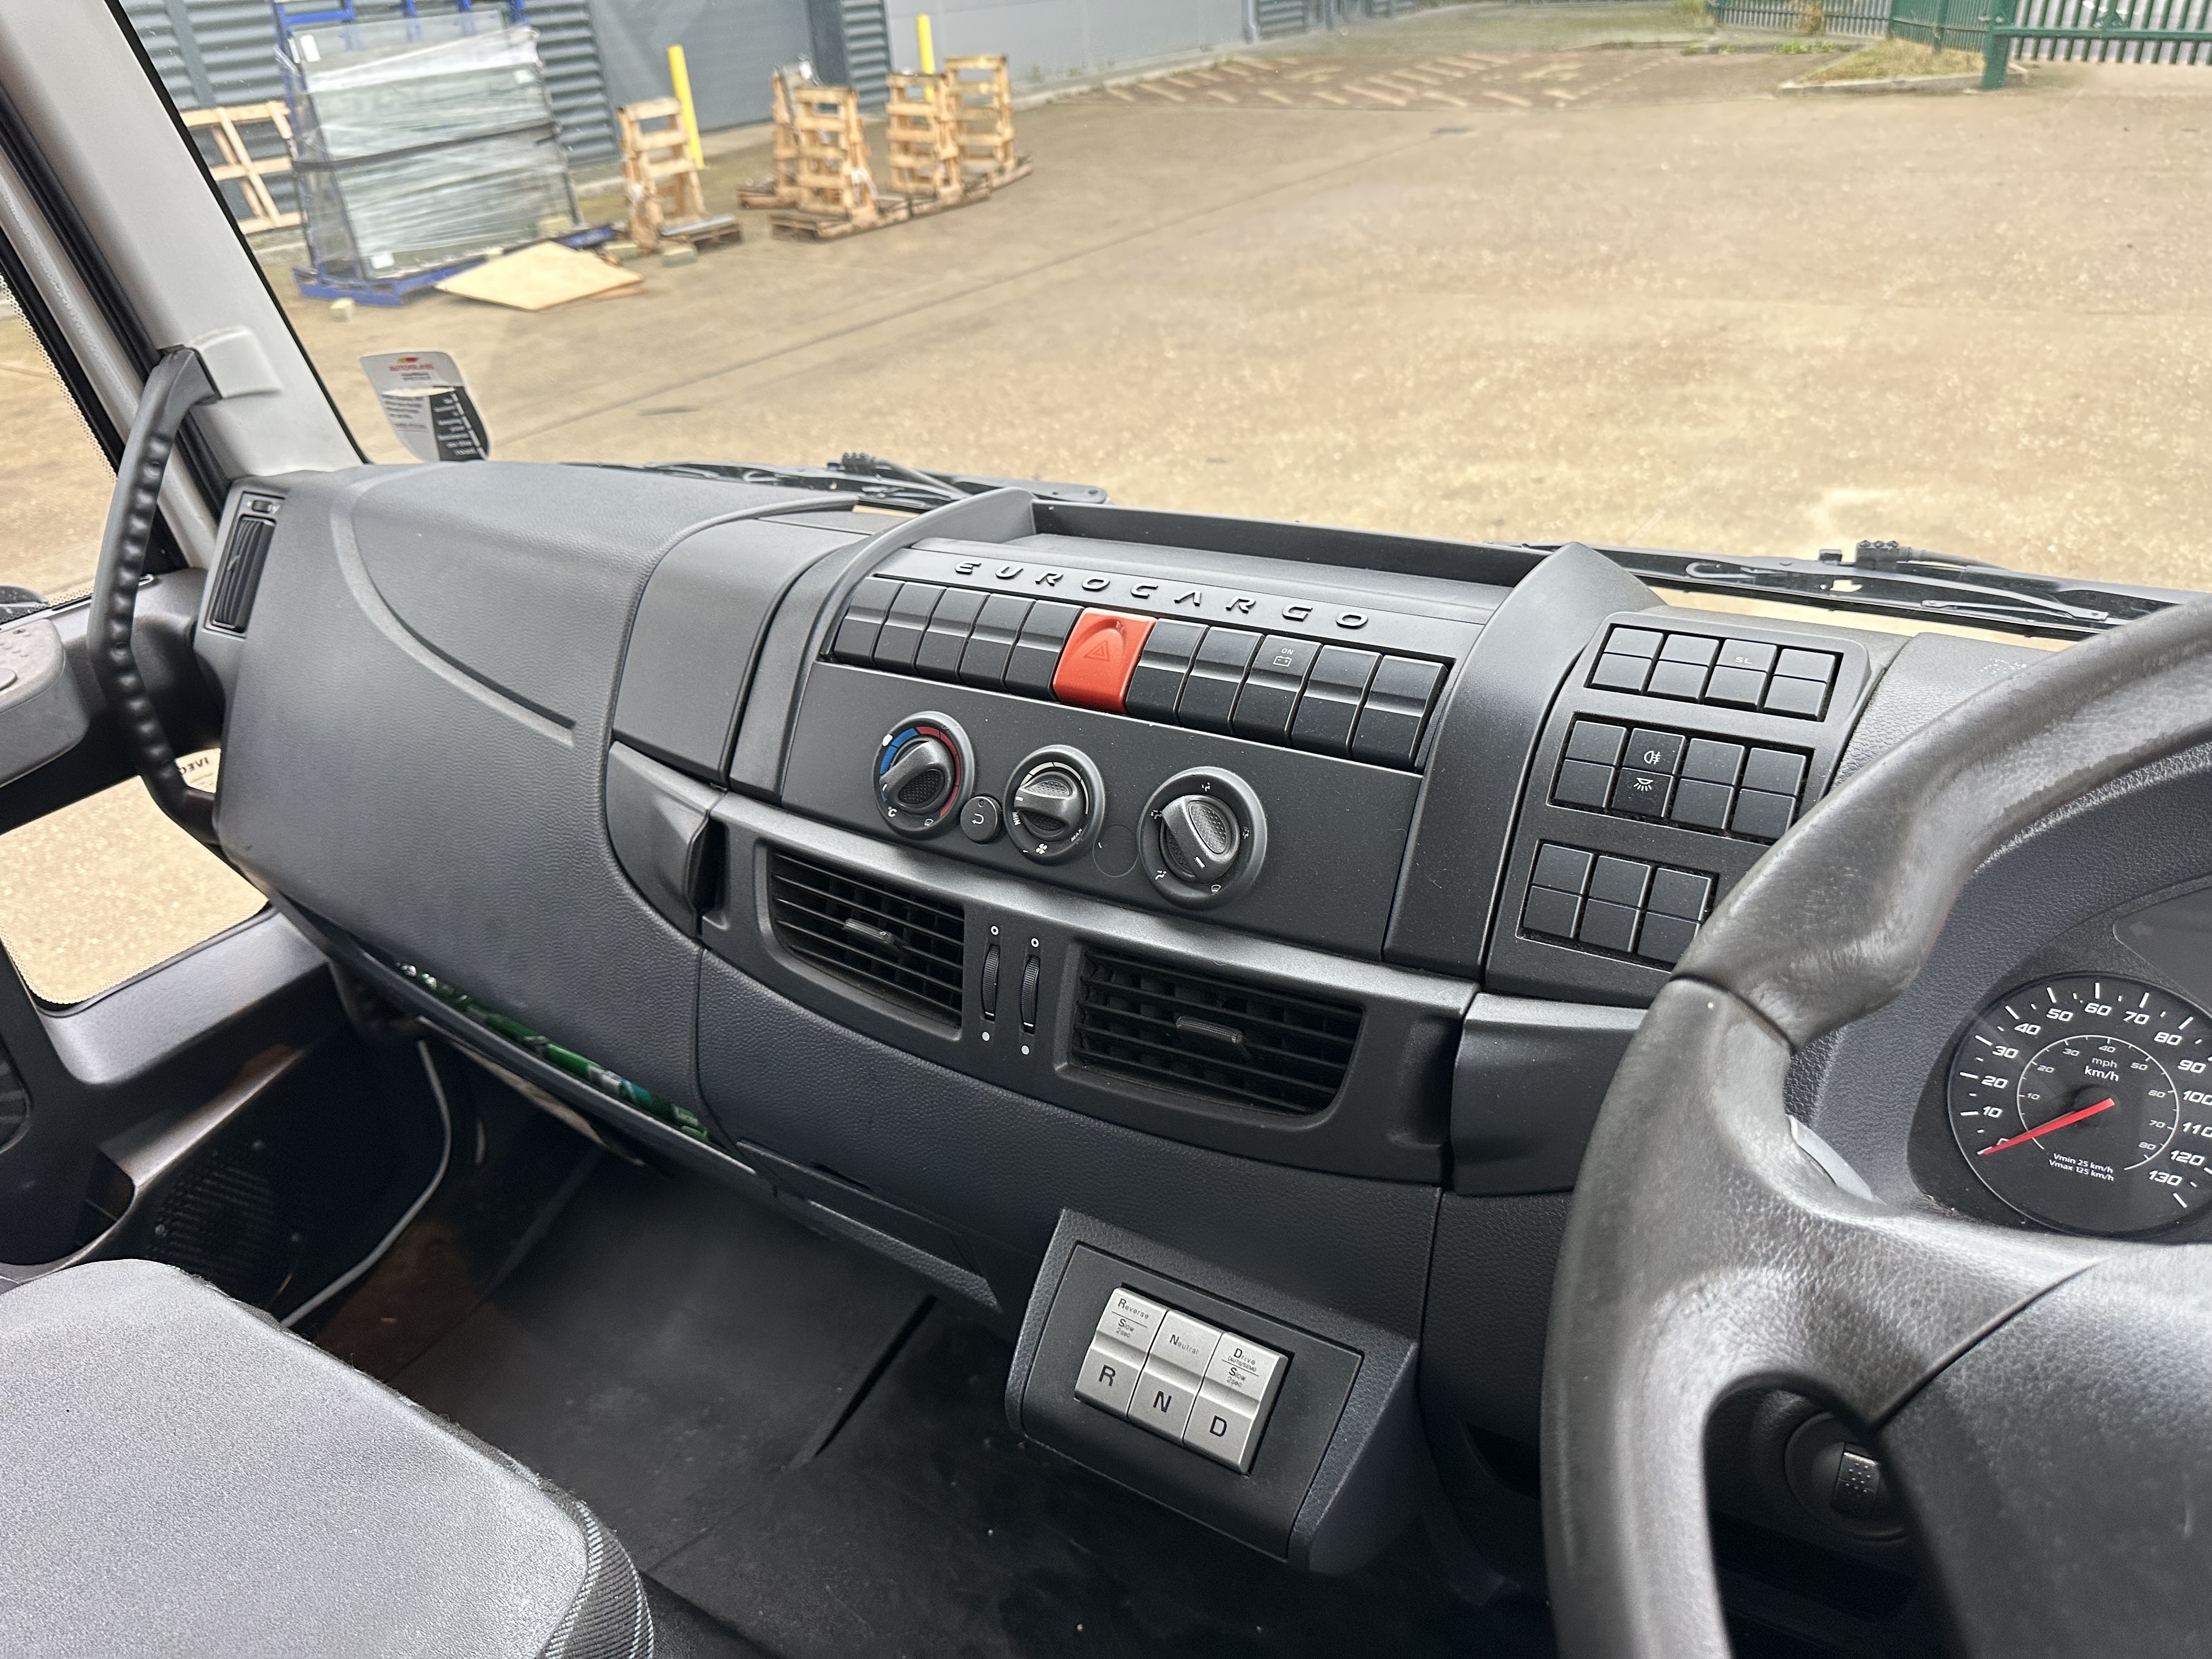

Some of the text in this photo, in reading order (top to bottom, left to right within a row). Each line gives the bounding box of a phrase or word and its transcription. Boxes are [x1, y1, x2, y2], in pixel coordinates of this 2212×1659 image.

[955, 560, 1369, 629] EUROCARGO
[1012, 811, 1021, 826] MIN
[1071, 828, 1082, 842] MAX
[2046, 1008, 2073, 1022] 50
[2084, 1004, 2112, 1016] 60
[2124, 1011, 2149, 1025] 70
[2014, 1024, 2041, 1036] 40
[2154, 1031, 2182, 1045] 80
[1992, 1045, 2018, 1058] 30
[2062, 1047, 2080, 1057] 30
[2098, 1045, 2116, 1053] 40
[2036, 1065, 2055, 1074] 20
[2091, 1056, 2118, 1069] mph
[2130, 1062, 2148, 1071] 50
[2177, 1059, 2206, 1074] 90
[2084, 1065, 2119, 1081] km/h
[1981, 1076, 2008, 1089] 20
[2148, 1090, 2165, 1098] 60
[2183, 1090, 2212, 1105] 100
[1983, 1106, 2002, 1118] 10
[2149, 1120, 2165, 1128] 70
[2183, 1122, 2212, 1138] 110
[2053, 1153, 2076, 1164] Vmin
[2090, 1162, 2113, 1173] km/h
[2170, 1150, 2205, 1166] 120
[2049, 1159, 2114, 1181] Vmax 125 km/h
[2149, 1170, 2182, 1186] 130
[1118, 1297, 1149, 1319] Reverse
[1118, 1318, 1135, 1332] Slow
[1116, 1328, 1131, 1338] 2sec
[1169, 1334, 1199, 1355] Neutral
[1233, 1347, 1255, 1365] Drive
[1098, 1364, 1116, 1386] R
[1229, 1367, 1246, 1381] Slow
[1227, 1376, 1242, 1387] 2sec
[1153, 1391, 1172, 1413] N
[1209, 1415, 1227, 1437] D
